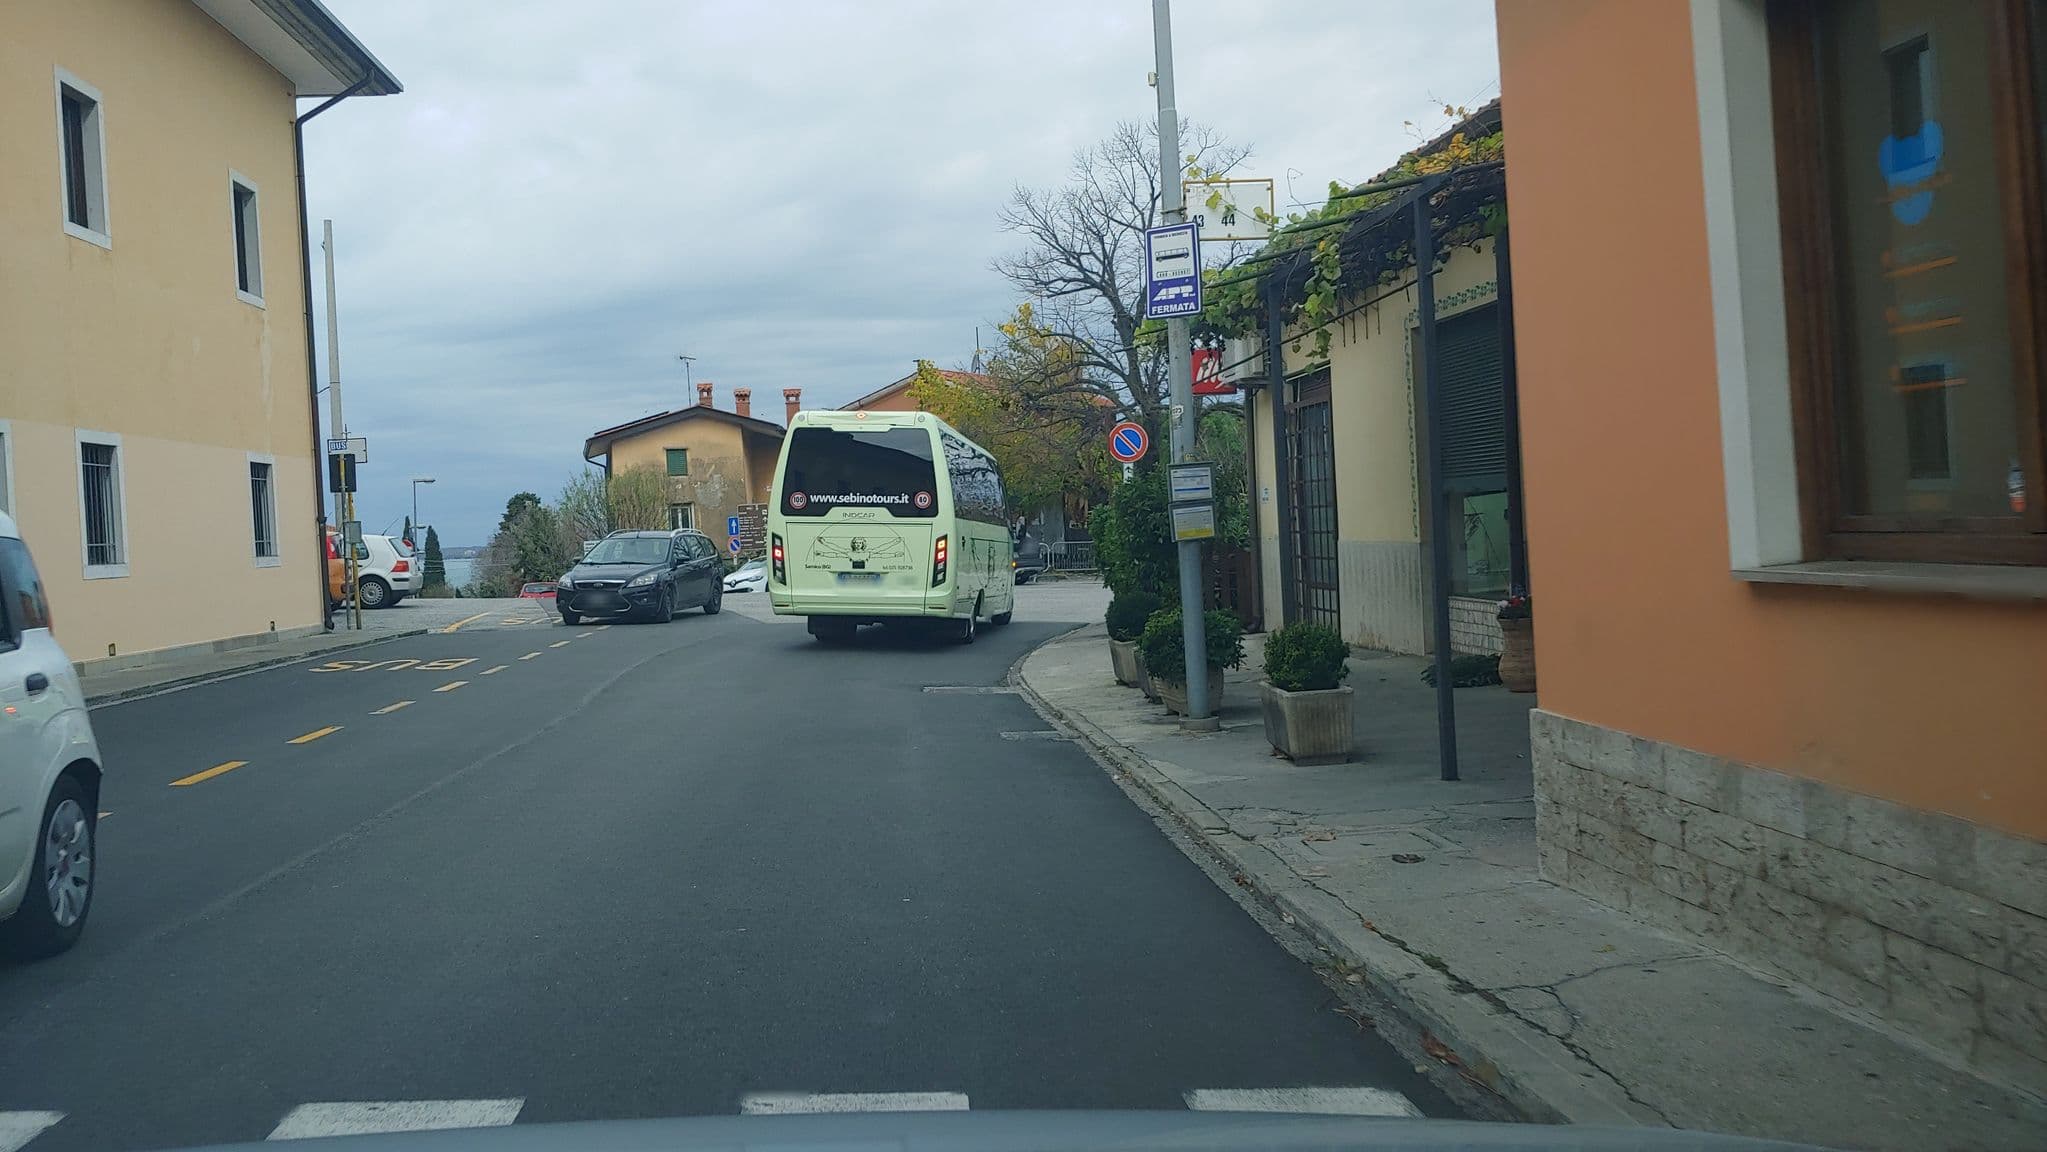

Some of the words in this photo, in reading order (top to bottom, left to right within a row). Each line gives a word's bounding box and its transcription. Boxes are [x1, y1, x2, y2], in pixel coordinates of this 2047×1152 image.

[1221, 213, 1236, 227] 44
[1152, 303, 1195, 314] FERMATA
[329, 440, 347, 451] BUS
[793, 496, 804, 504] 100
[810, 493, 909, 504] www.sebinotours.it
